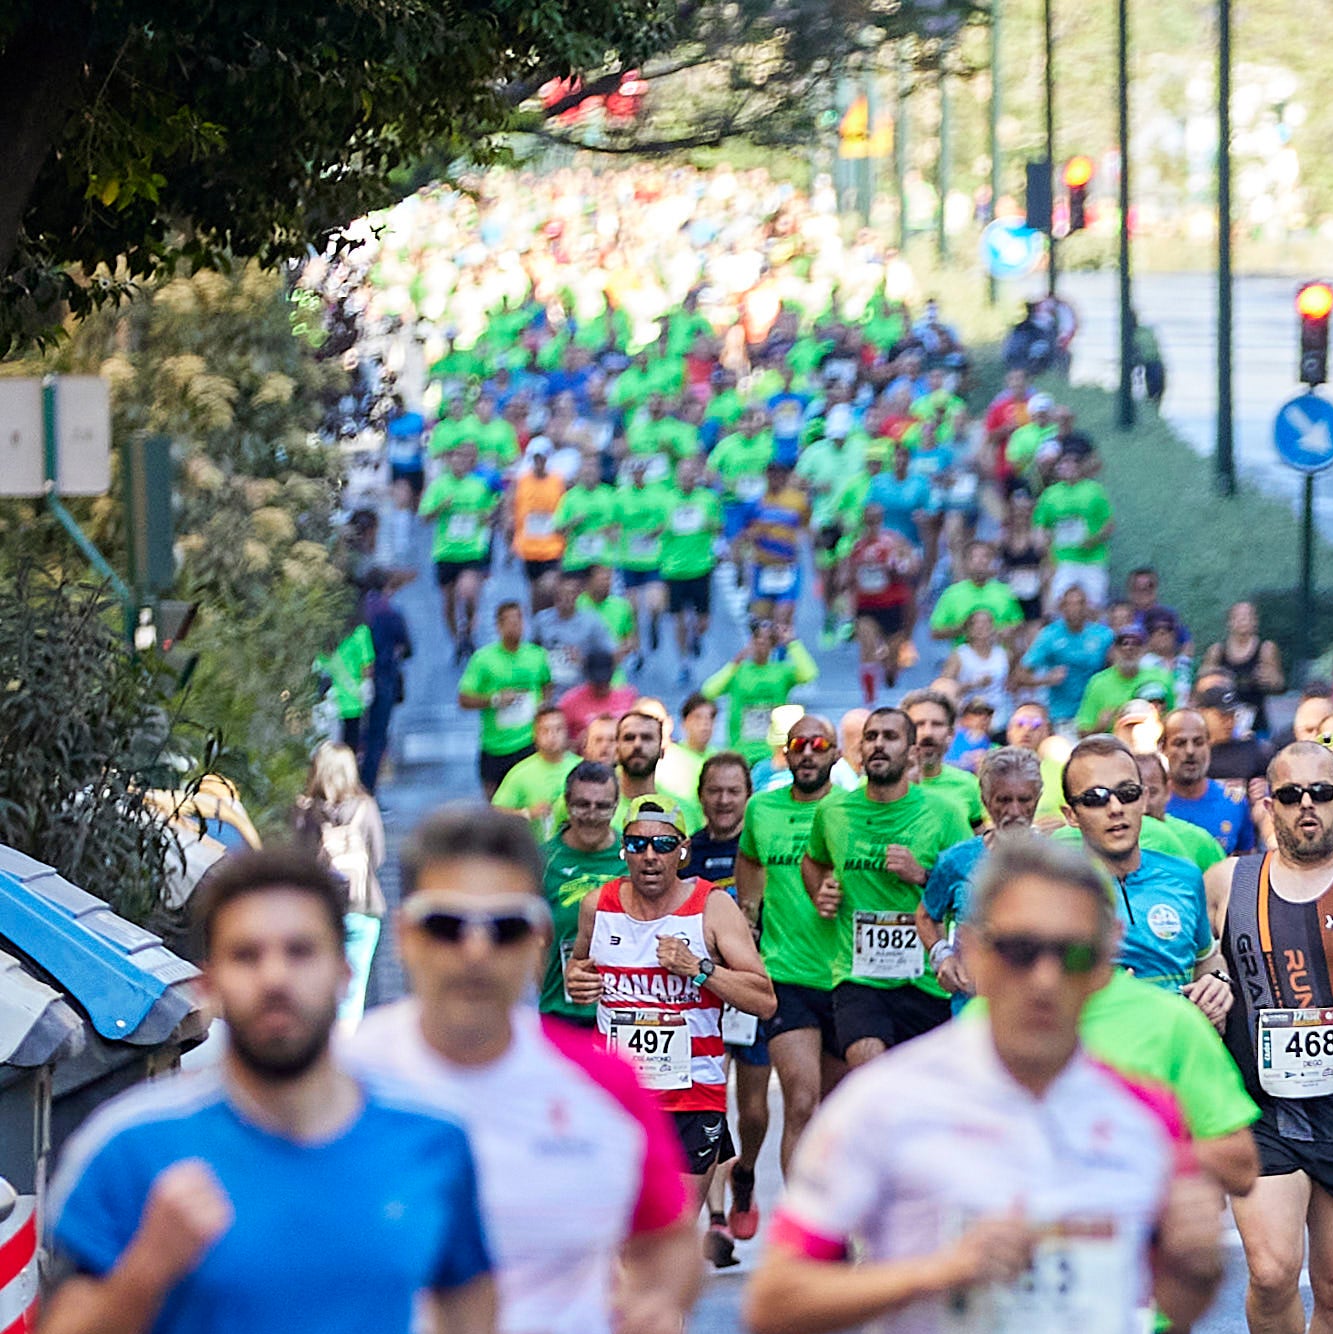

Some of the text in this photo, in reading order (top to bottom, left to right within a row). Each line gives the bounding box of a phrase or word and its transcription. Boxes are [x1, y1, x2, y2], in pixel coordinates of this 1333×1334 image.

[866, 928, 917, 949] 1982
[603, 972, 700, 997] RANADA
[628, 1029, 675, 1054] 497
